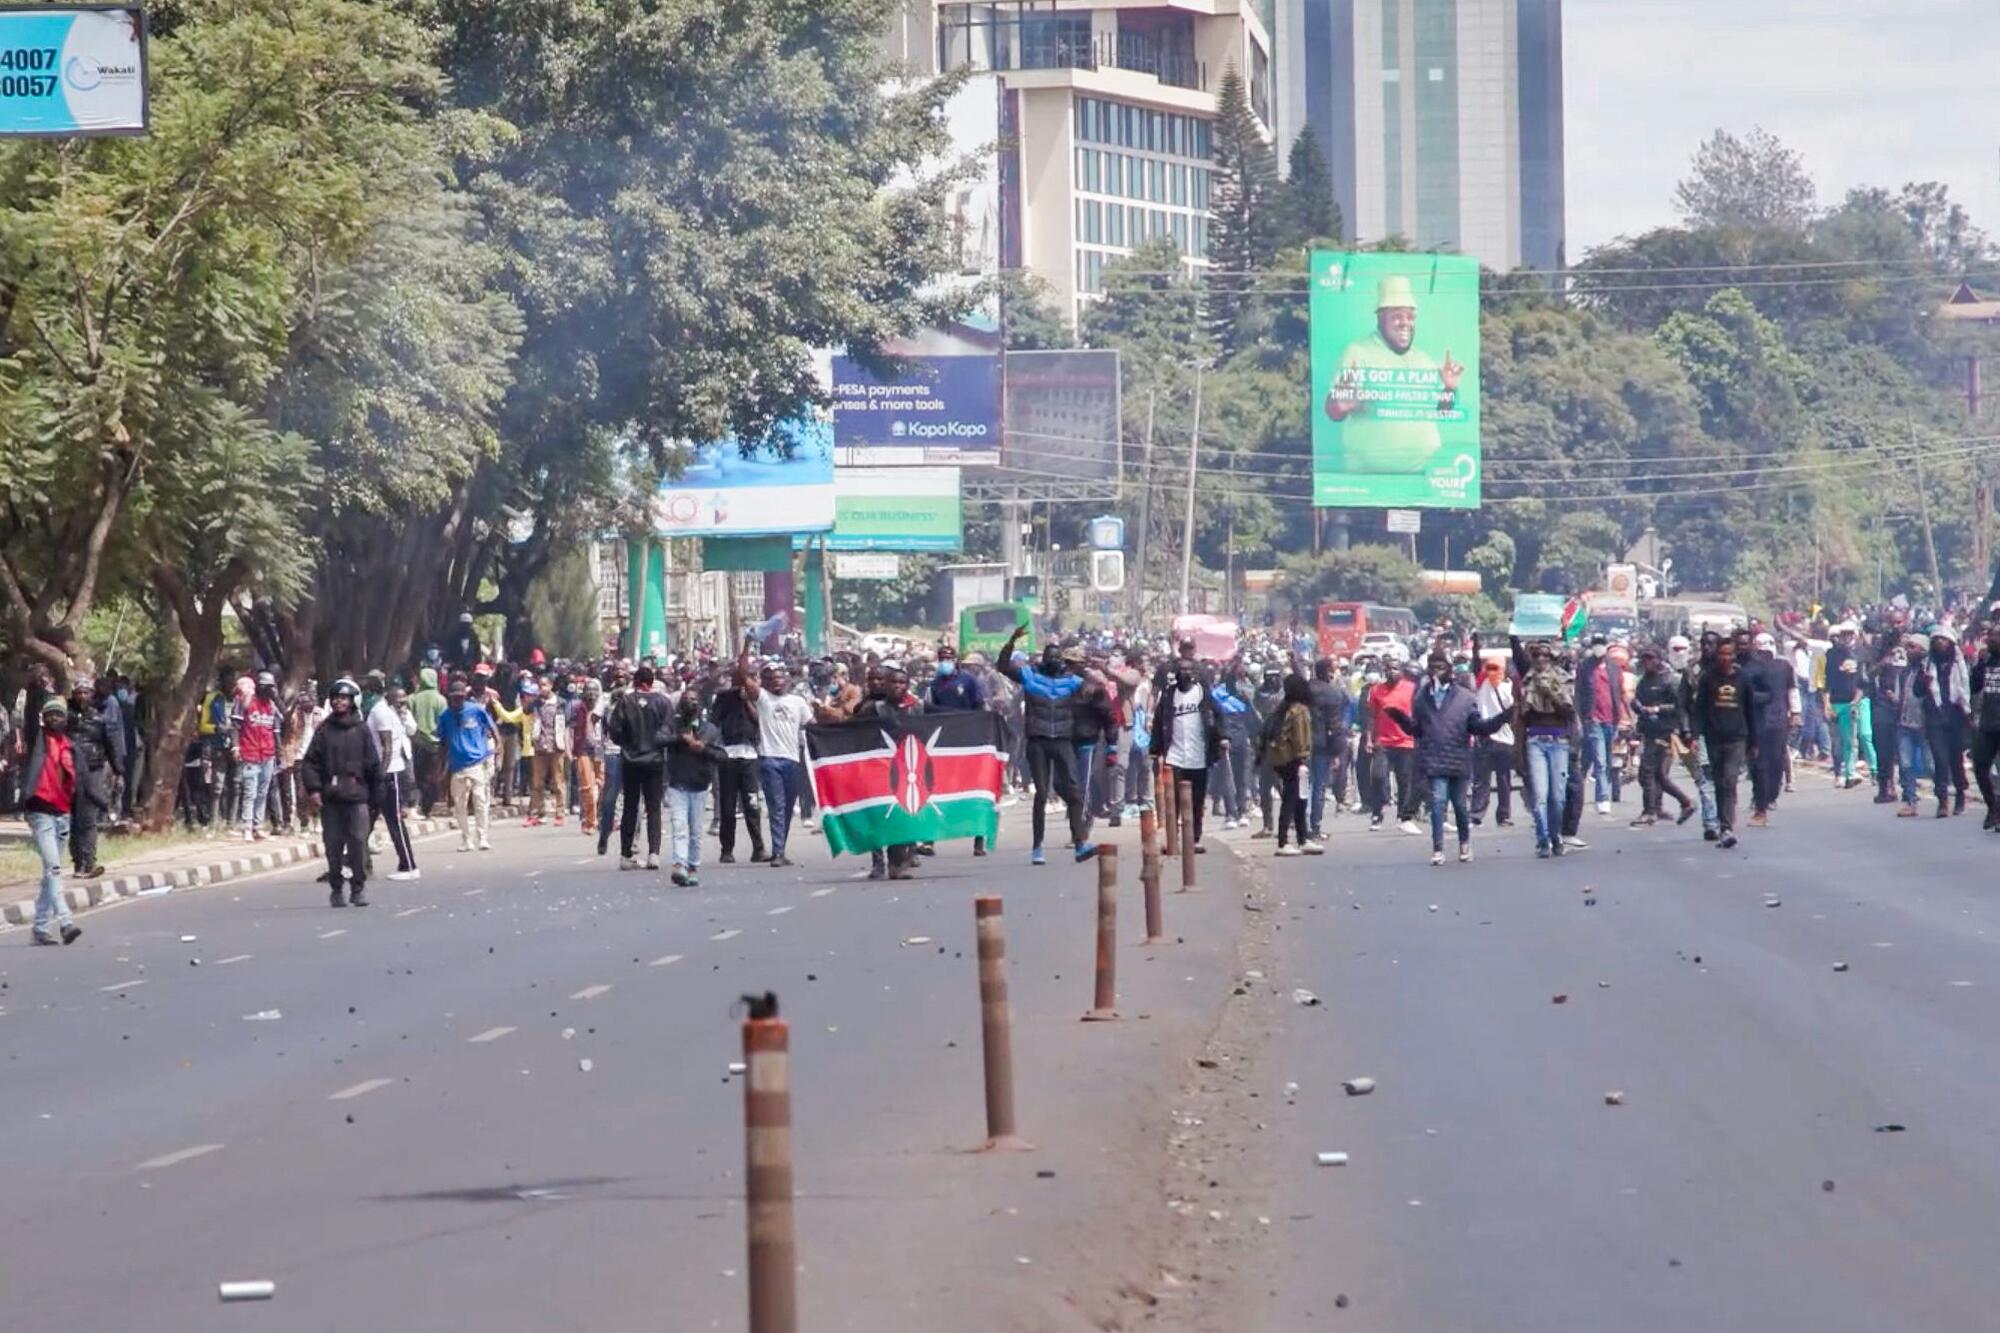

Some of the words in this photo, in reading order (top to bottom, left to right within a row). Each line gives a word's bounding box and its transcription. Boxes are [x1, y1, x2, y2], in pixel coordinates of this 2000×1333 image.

[0, 49, 57, 70] 4007
[1369, 370, 1392, 382] GOT
[1395, 371, 1406, 383] A
[1408, 371, 1438, 384] PLAN
[868, 384, 930, 398] payments
[1331, 389, 1354, 400] THAT
[869, 400, 879, 410] &
[881, 400, 914, 410] more
[915, 399, 945, 410] tools
[852, 511, 878, 521] OUR
